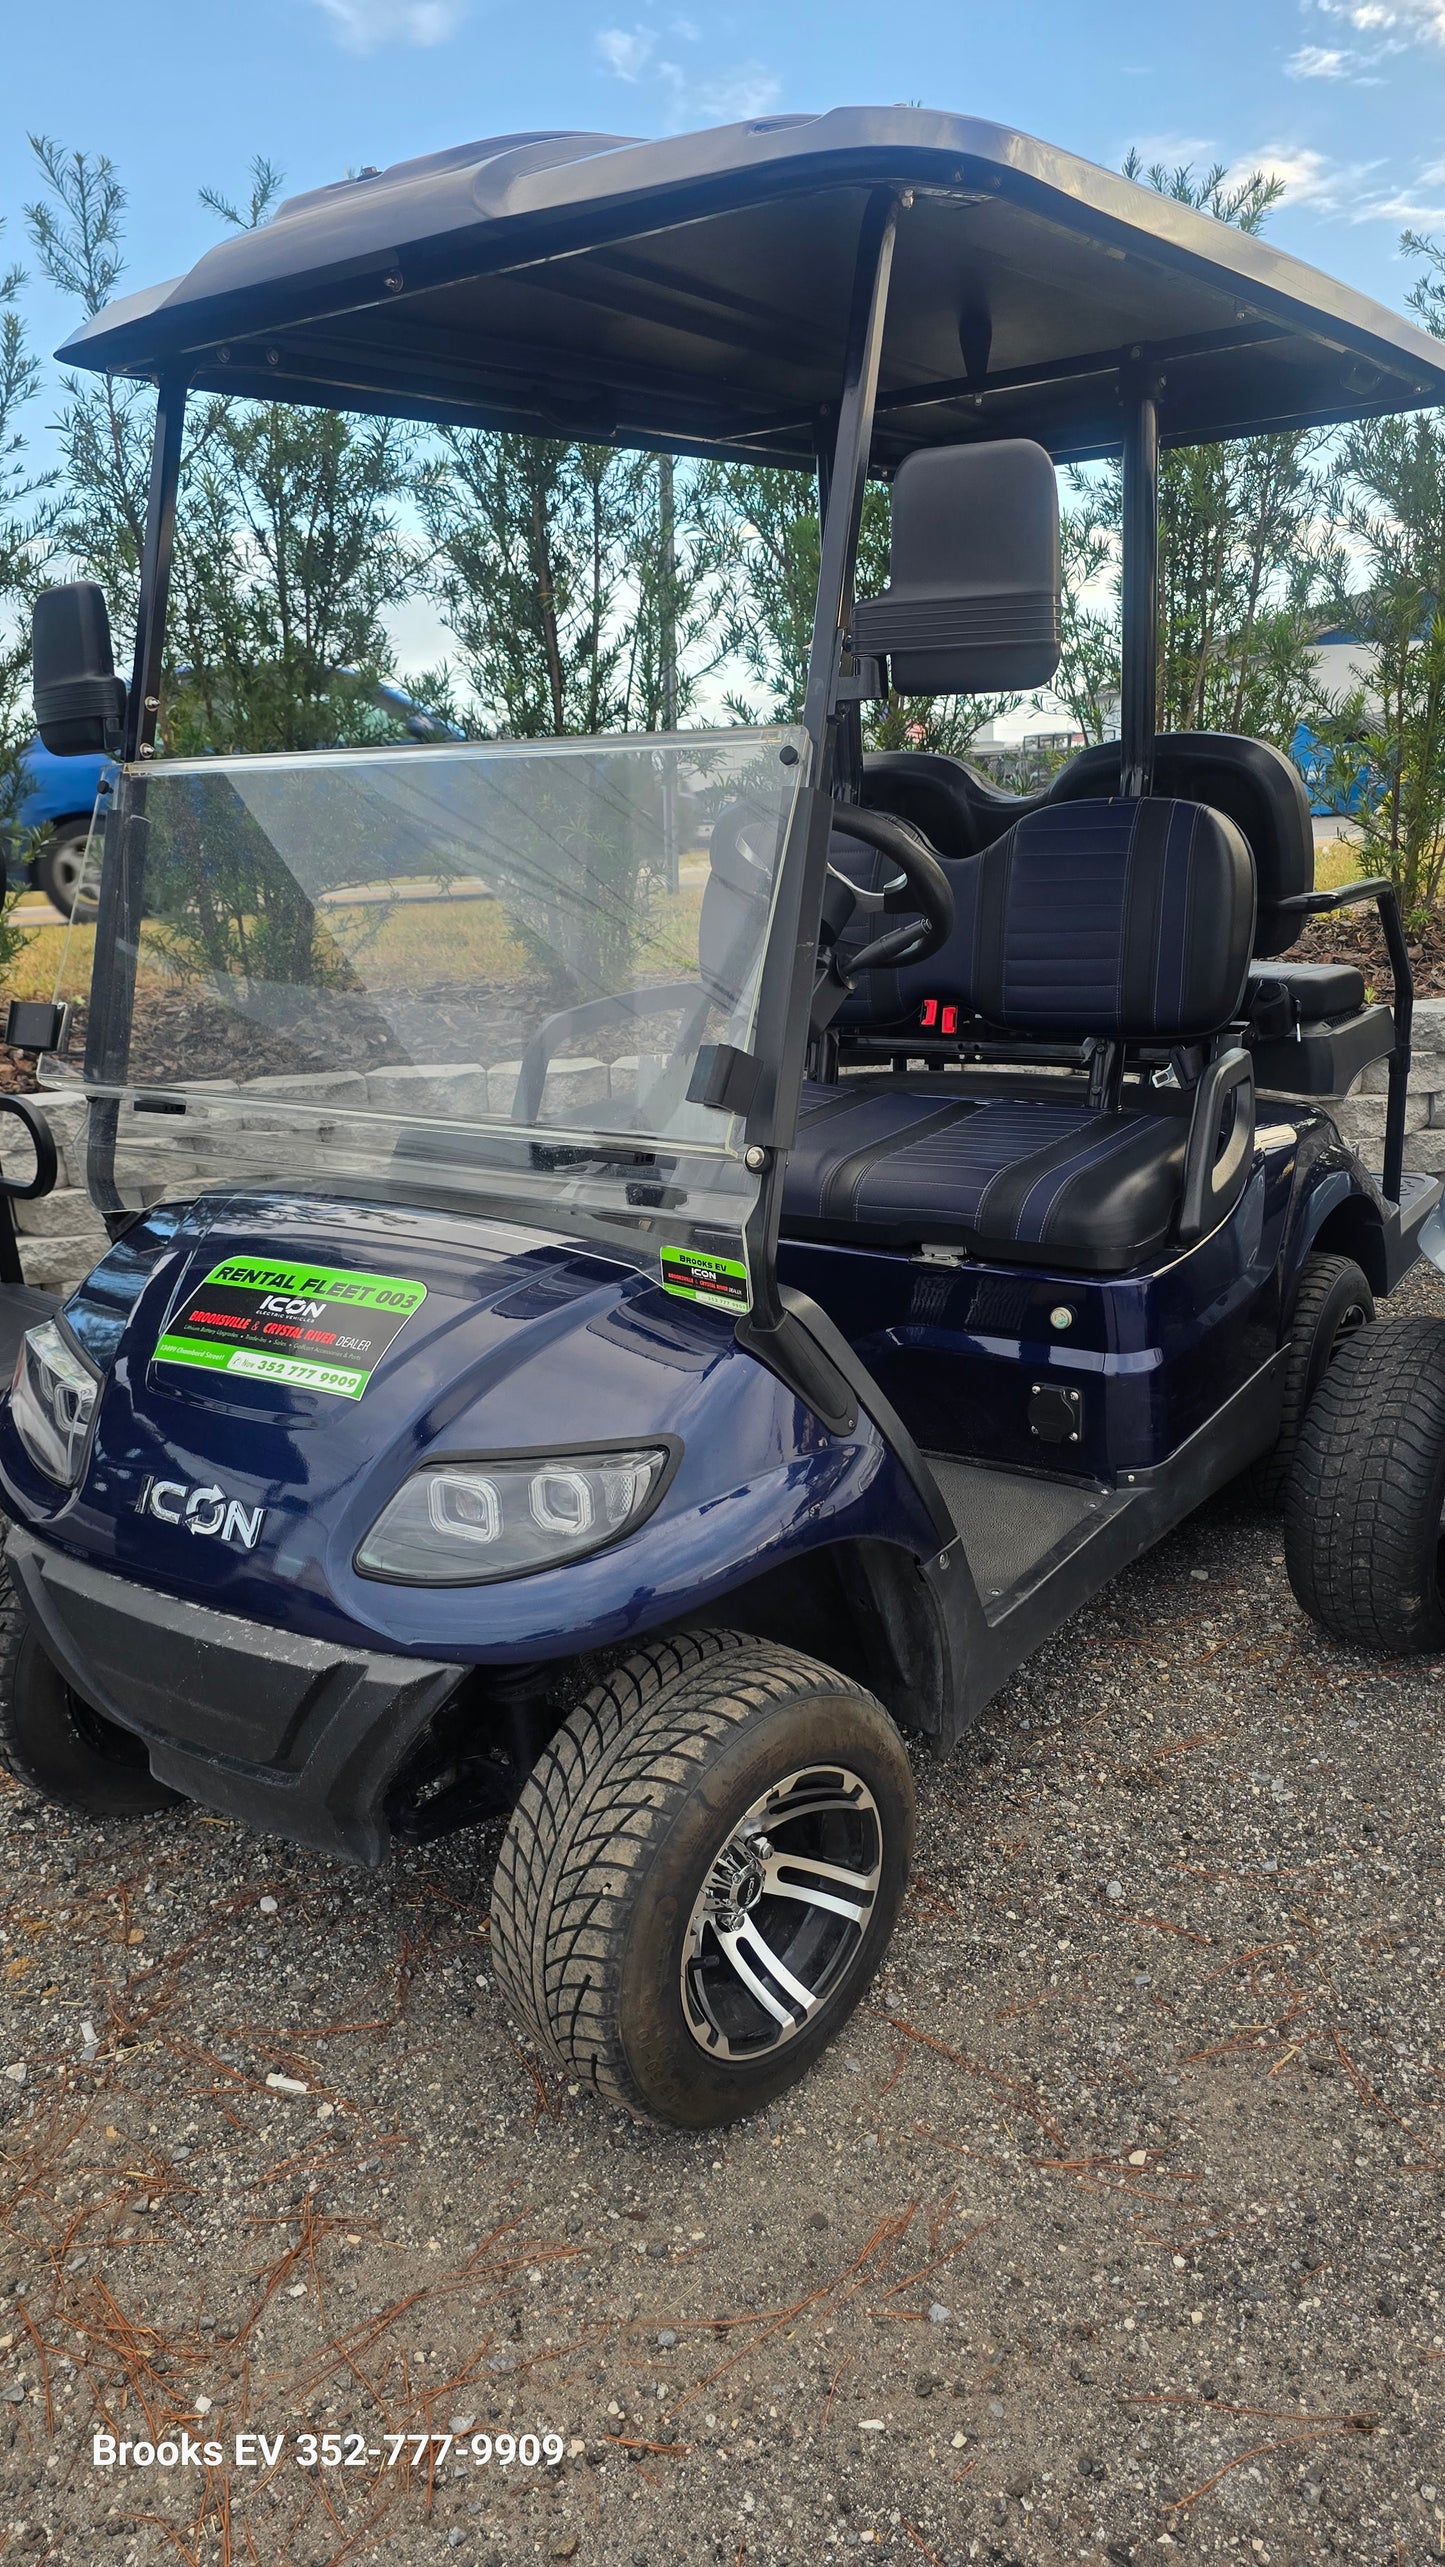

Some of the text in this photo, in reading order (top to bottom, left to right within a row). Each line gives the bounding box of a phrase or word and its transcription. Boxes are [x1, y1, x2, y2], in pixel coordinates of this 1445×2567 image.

[679, 1255, 726, 1271] BROOKS EV
[691, 1268, 716, 1279] ICON
[214, 1266, 418, 1309] RENTAL FLEET 003
[255, 1310, 315, 1324] ELECTRIC VEHICLES
[259, 1295, 327, 1319] ICON
[188, 1310, 372, 1352] BROOKSVILLE & CRYSTAL RIVER DEALER
[257, 1360, 285, 1374] 352
[287, 1366, 318, 1380] 777
[319, 1372, 357, 1388] 9909
[134, 1474, 266, 1549] ICON
[744, 1877, 755, 1905] ICON
